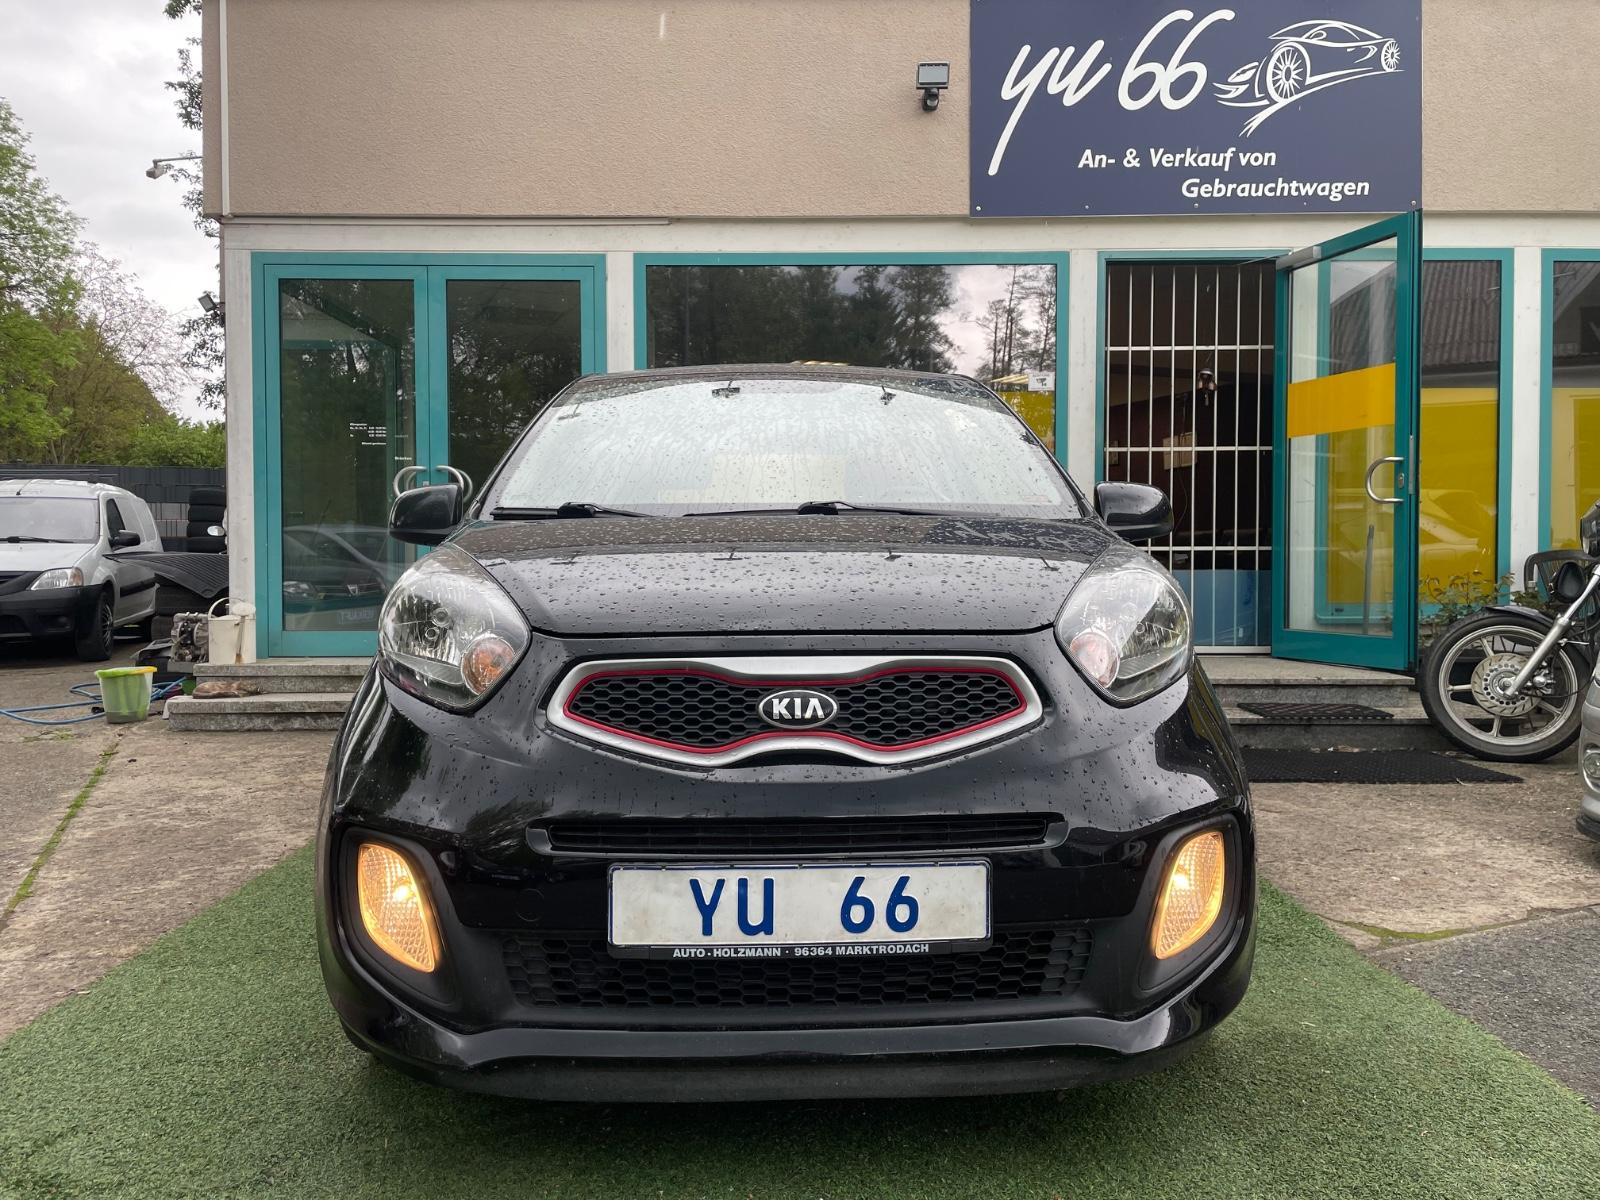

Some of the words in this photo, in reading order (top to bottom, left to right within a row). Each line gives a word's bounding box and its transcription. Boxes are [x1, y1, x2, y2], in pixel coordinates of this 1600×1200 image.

[1117, 9, 1236, 111] 66
[1078, 148, 1116, 169] An-
[1122, 148, 1141, 168] &
[1149, 146, 1235, 172] Verkauf
[1238, 150, 1277, 167] von
[1181, 177, 1370, 202] Gebrauchtwagen
[771, 697, 825, 720] KIA
[689, 877, 774, 936] YU
[840, 875, 919, 934] 66
[794, 946, 833, 957] 96364
[835, 943, 929, 956] MARKTRODACH
